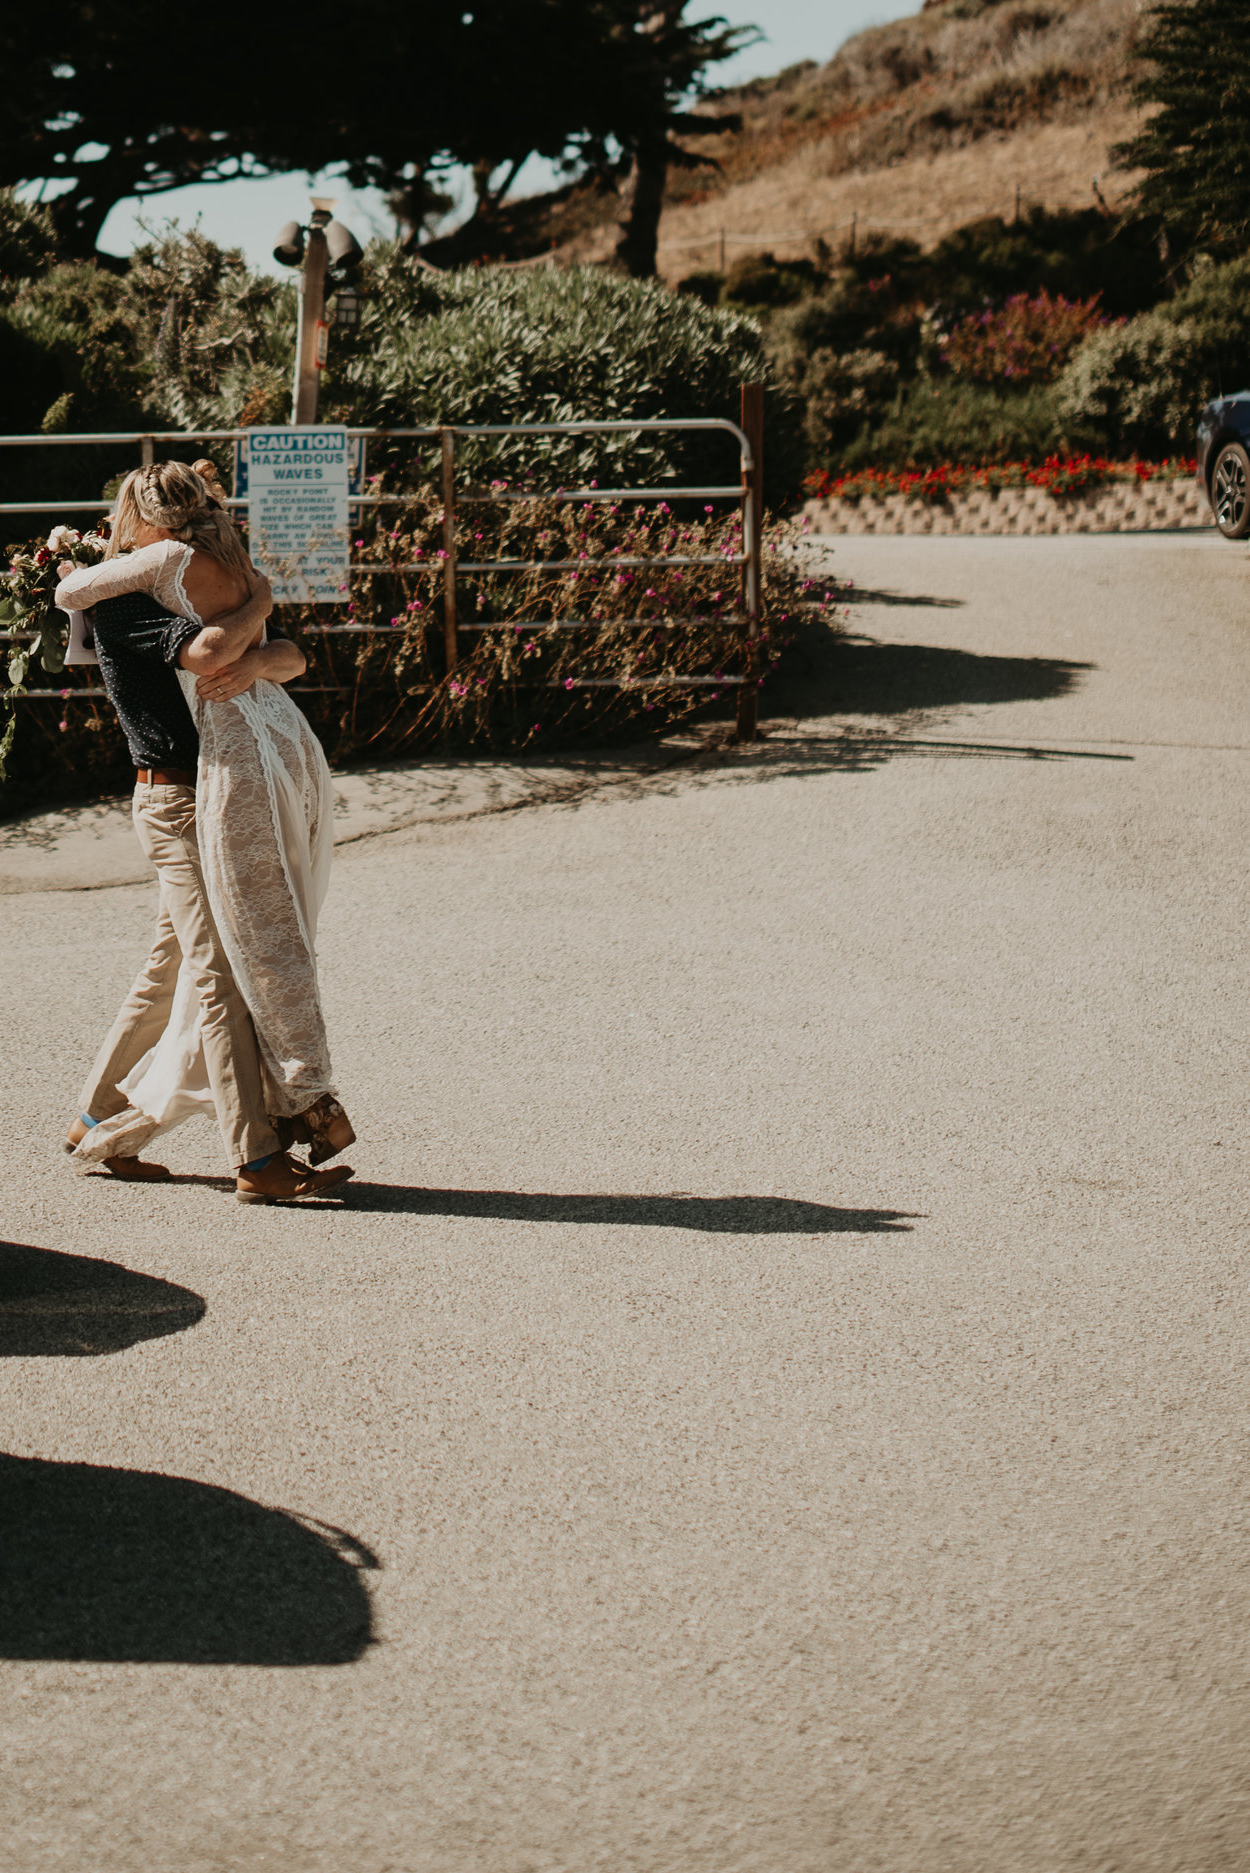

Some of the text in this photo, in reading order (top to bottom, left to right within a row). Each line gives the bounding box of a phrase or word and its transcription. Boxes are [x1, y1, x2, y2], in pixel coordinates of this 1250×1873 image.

[253, 435, 342, 450] CAUTION
[251, 453, 344, 465] HAZARDOUS
[273, 469, 323, 480] WAVES
[272, 497, 336, 505] OCCASIONALLY
[297, 505, 334, 513] RANDOM
[316, 556, 345, 565] YOUR
